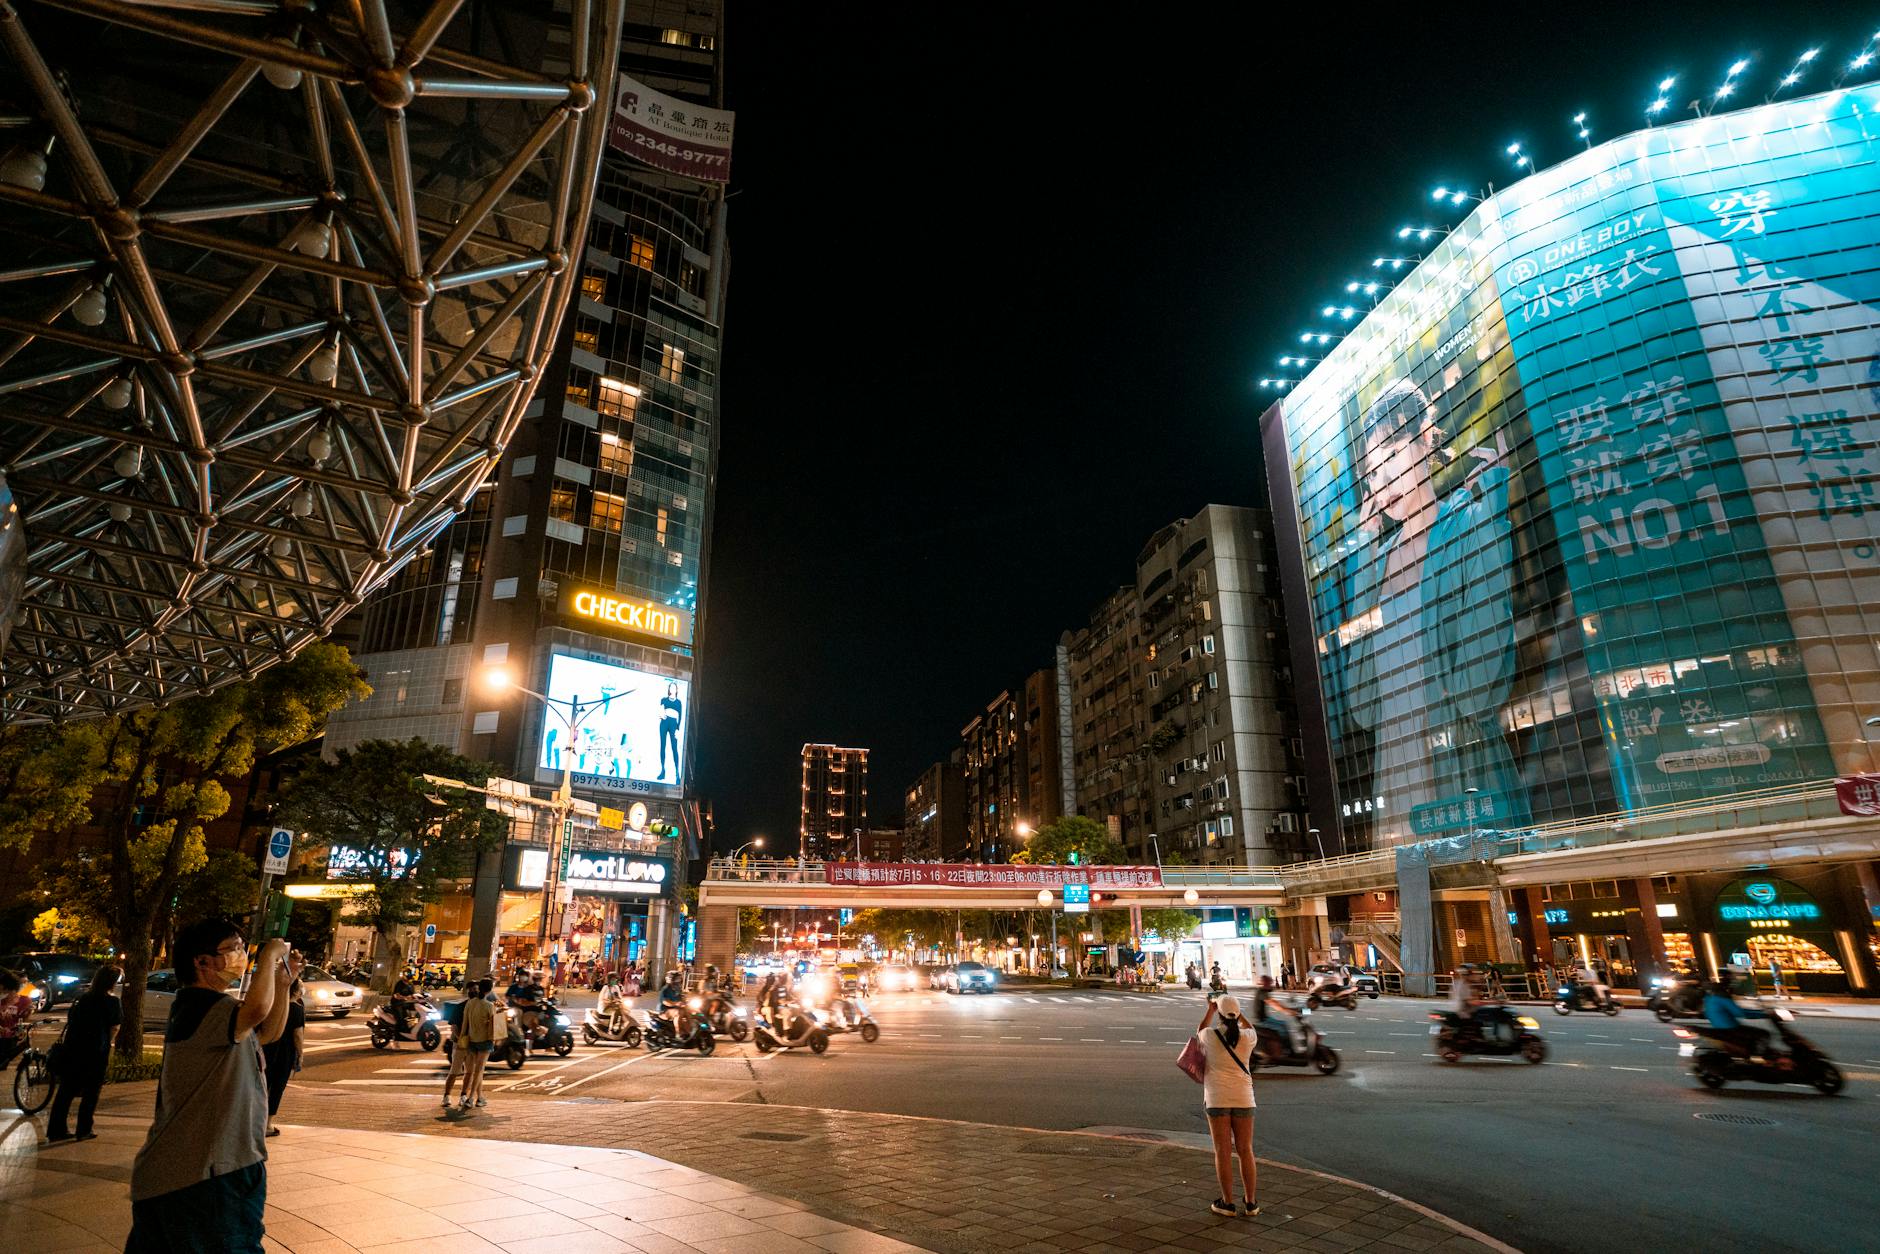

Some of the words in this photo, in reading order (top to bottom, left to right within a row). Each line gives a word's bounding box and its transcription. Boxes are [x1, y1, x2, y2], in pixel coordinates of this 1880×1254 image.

[616, 125, 634, 141] (02)
[634, 132, 726, 167] 2345-9777
[663, 120, 703, 138] Boutique
[704, 130, 730, 143] Hotel
[1545, 235, 1593, 264] ONE
[1598, 213, 1648, 244] BOY
[1512, 244, 1663, 323] 冰鋒衣
[1577, 483, 1730, 565] NO.1
[574, 592, 643, 629] CHECK
[645, 602, 680, 637] inn
[1722, 905, 1767, 918] BUNA
[1770, 904, 1818, 918] CAFE
